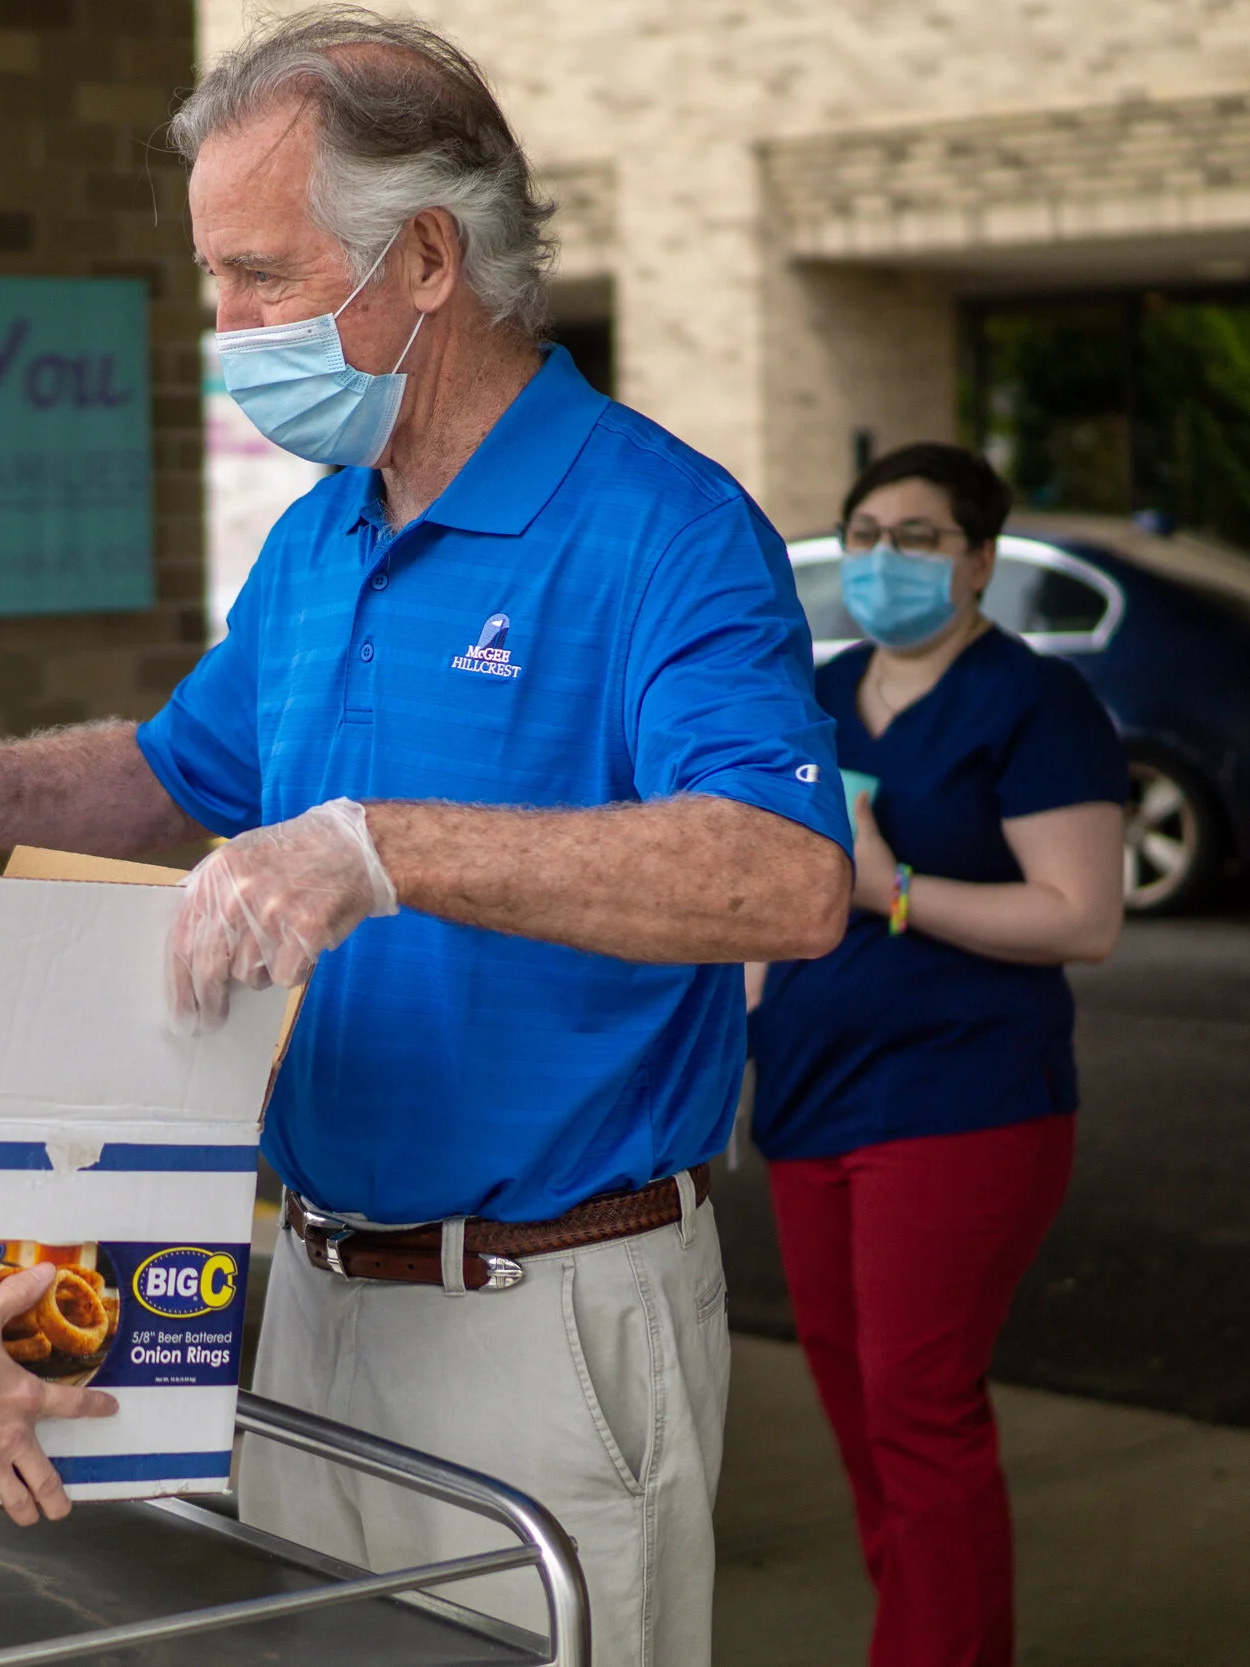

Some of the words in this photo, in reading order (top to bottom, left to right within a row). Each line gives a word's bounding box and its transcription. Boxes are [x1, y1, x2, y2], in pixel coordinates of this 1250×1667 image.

[465, 645, 511, 663] McGEE
[451, 656, 522, 678] HILLCREST
[146, 1267, 198, 1298] BIG
[158, 1332, 183, 1344] Beer
[185, 1331, 232, 1345] Battered
[130, 1346, 181, 1364] Onion
[186, 1346, 230, 1367] Rings
